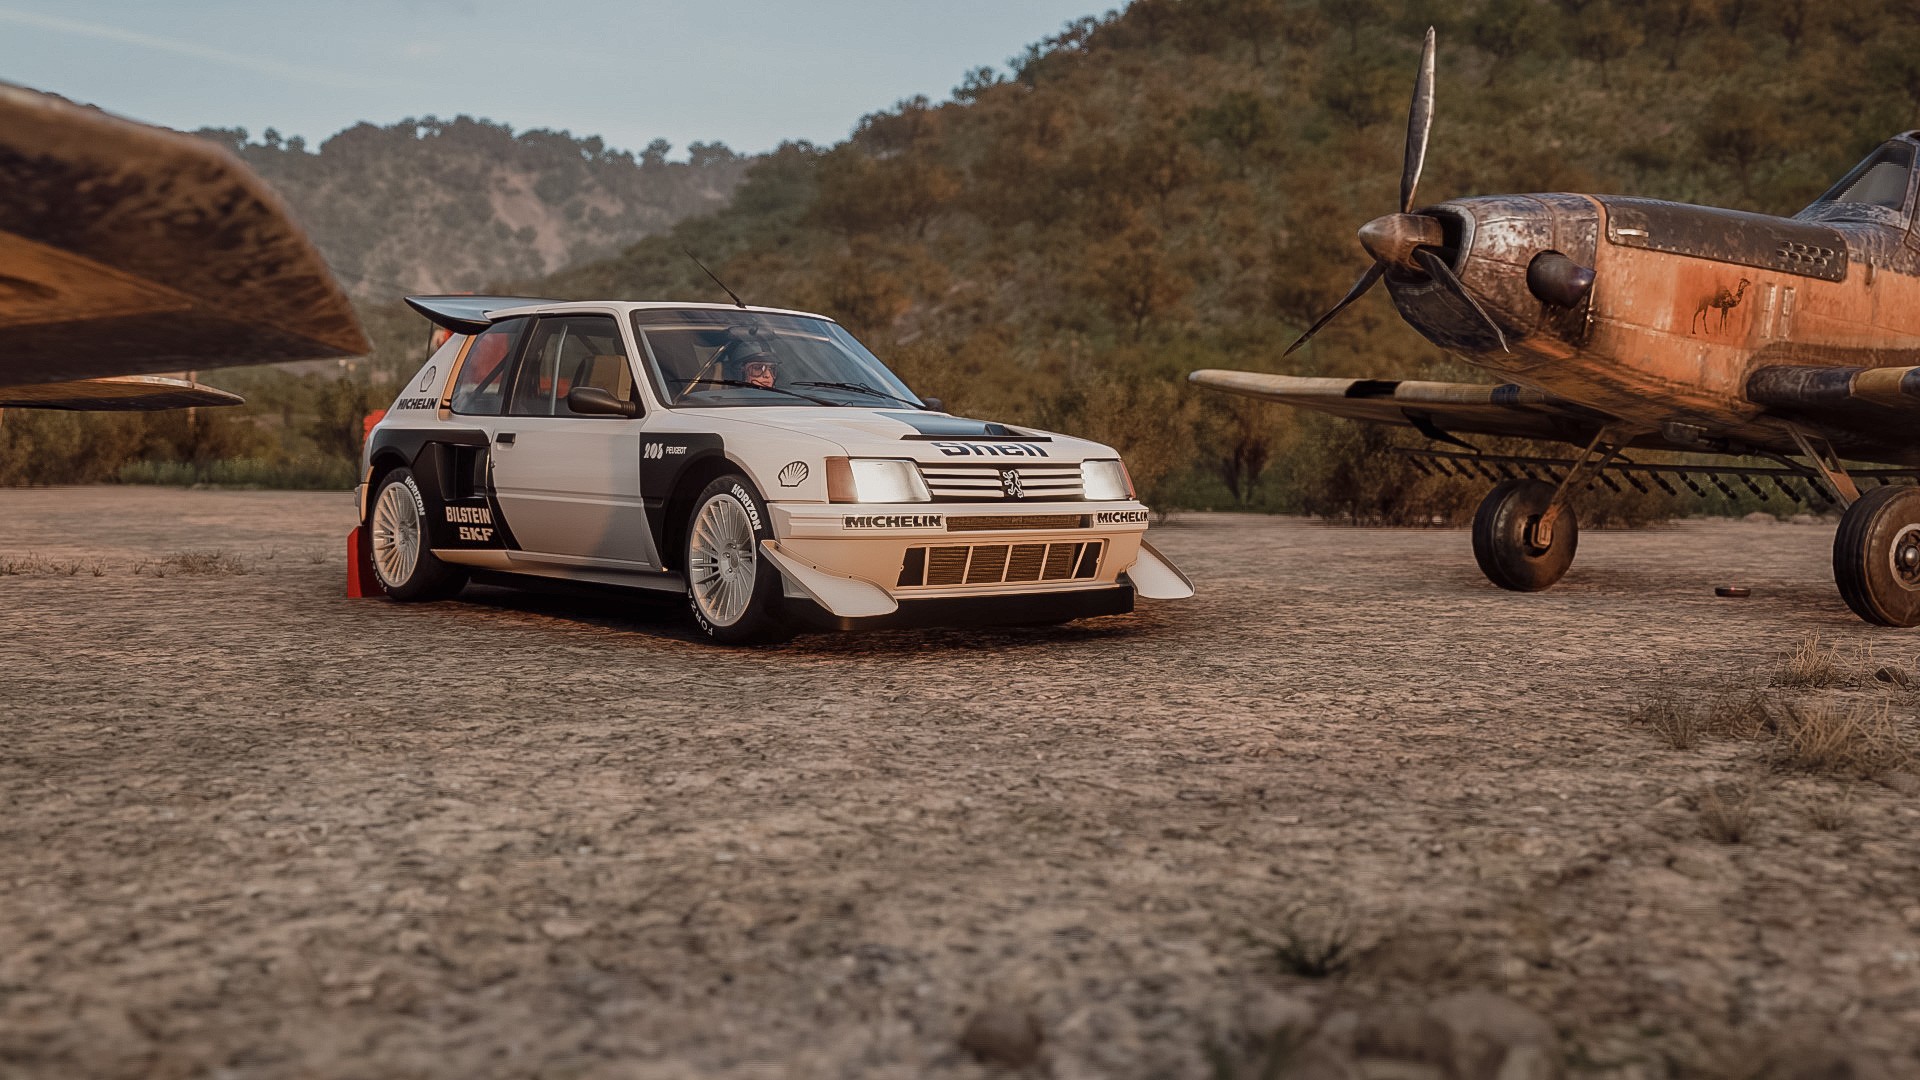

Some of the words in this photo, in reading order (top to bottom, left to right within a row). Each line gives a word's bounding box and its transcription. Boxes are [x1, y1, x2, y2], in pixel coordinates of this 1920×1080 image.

[396, 398, 438, 410] MICHELIN
[643, 442, 664, 459] 205
[665, 446, 687, 455] PEUGEOT
[930, 442, 1049, 457] Shell
[405, 475, 426, 517] HORIZON
[446, 506, 491, 524] BILSTEIN
[731, 483, 762, 531] HORIZON
[844, 514, 942, 528] MICHELIN
[460, 526, 494, 542] SKF
